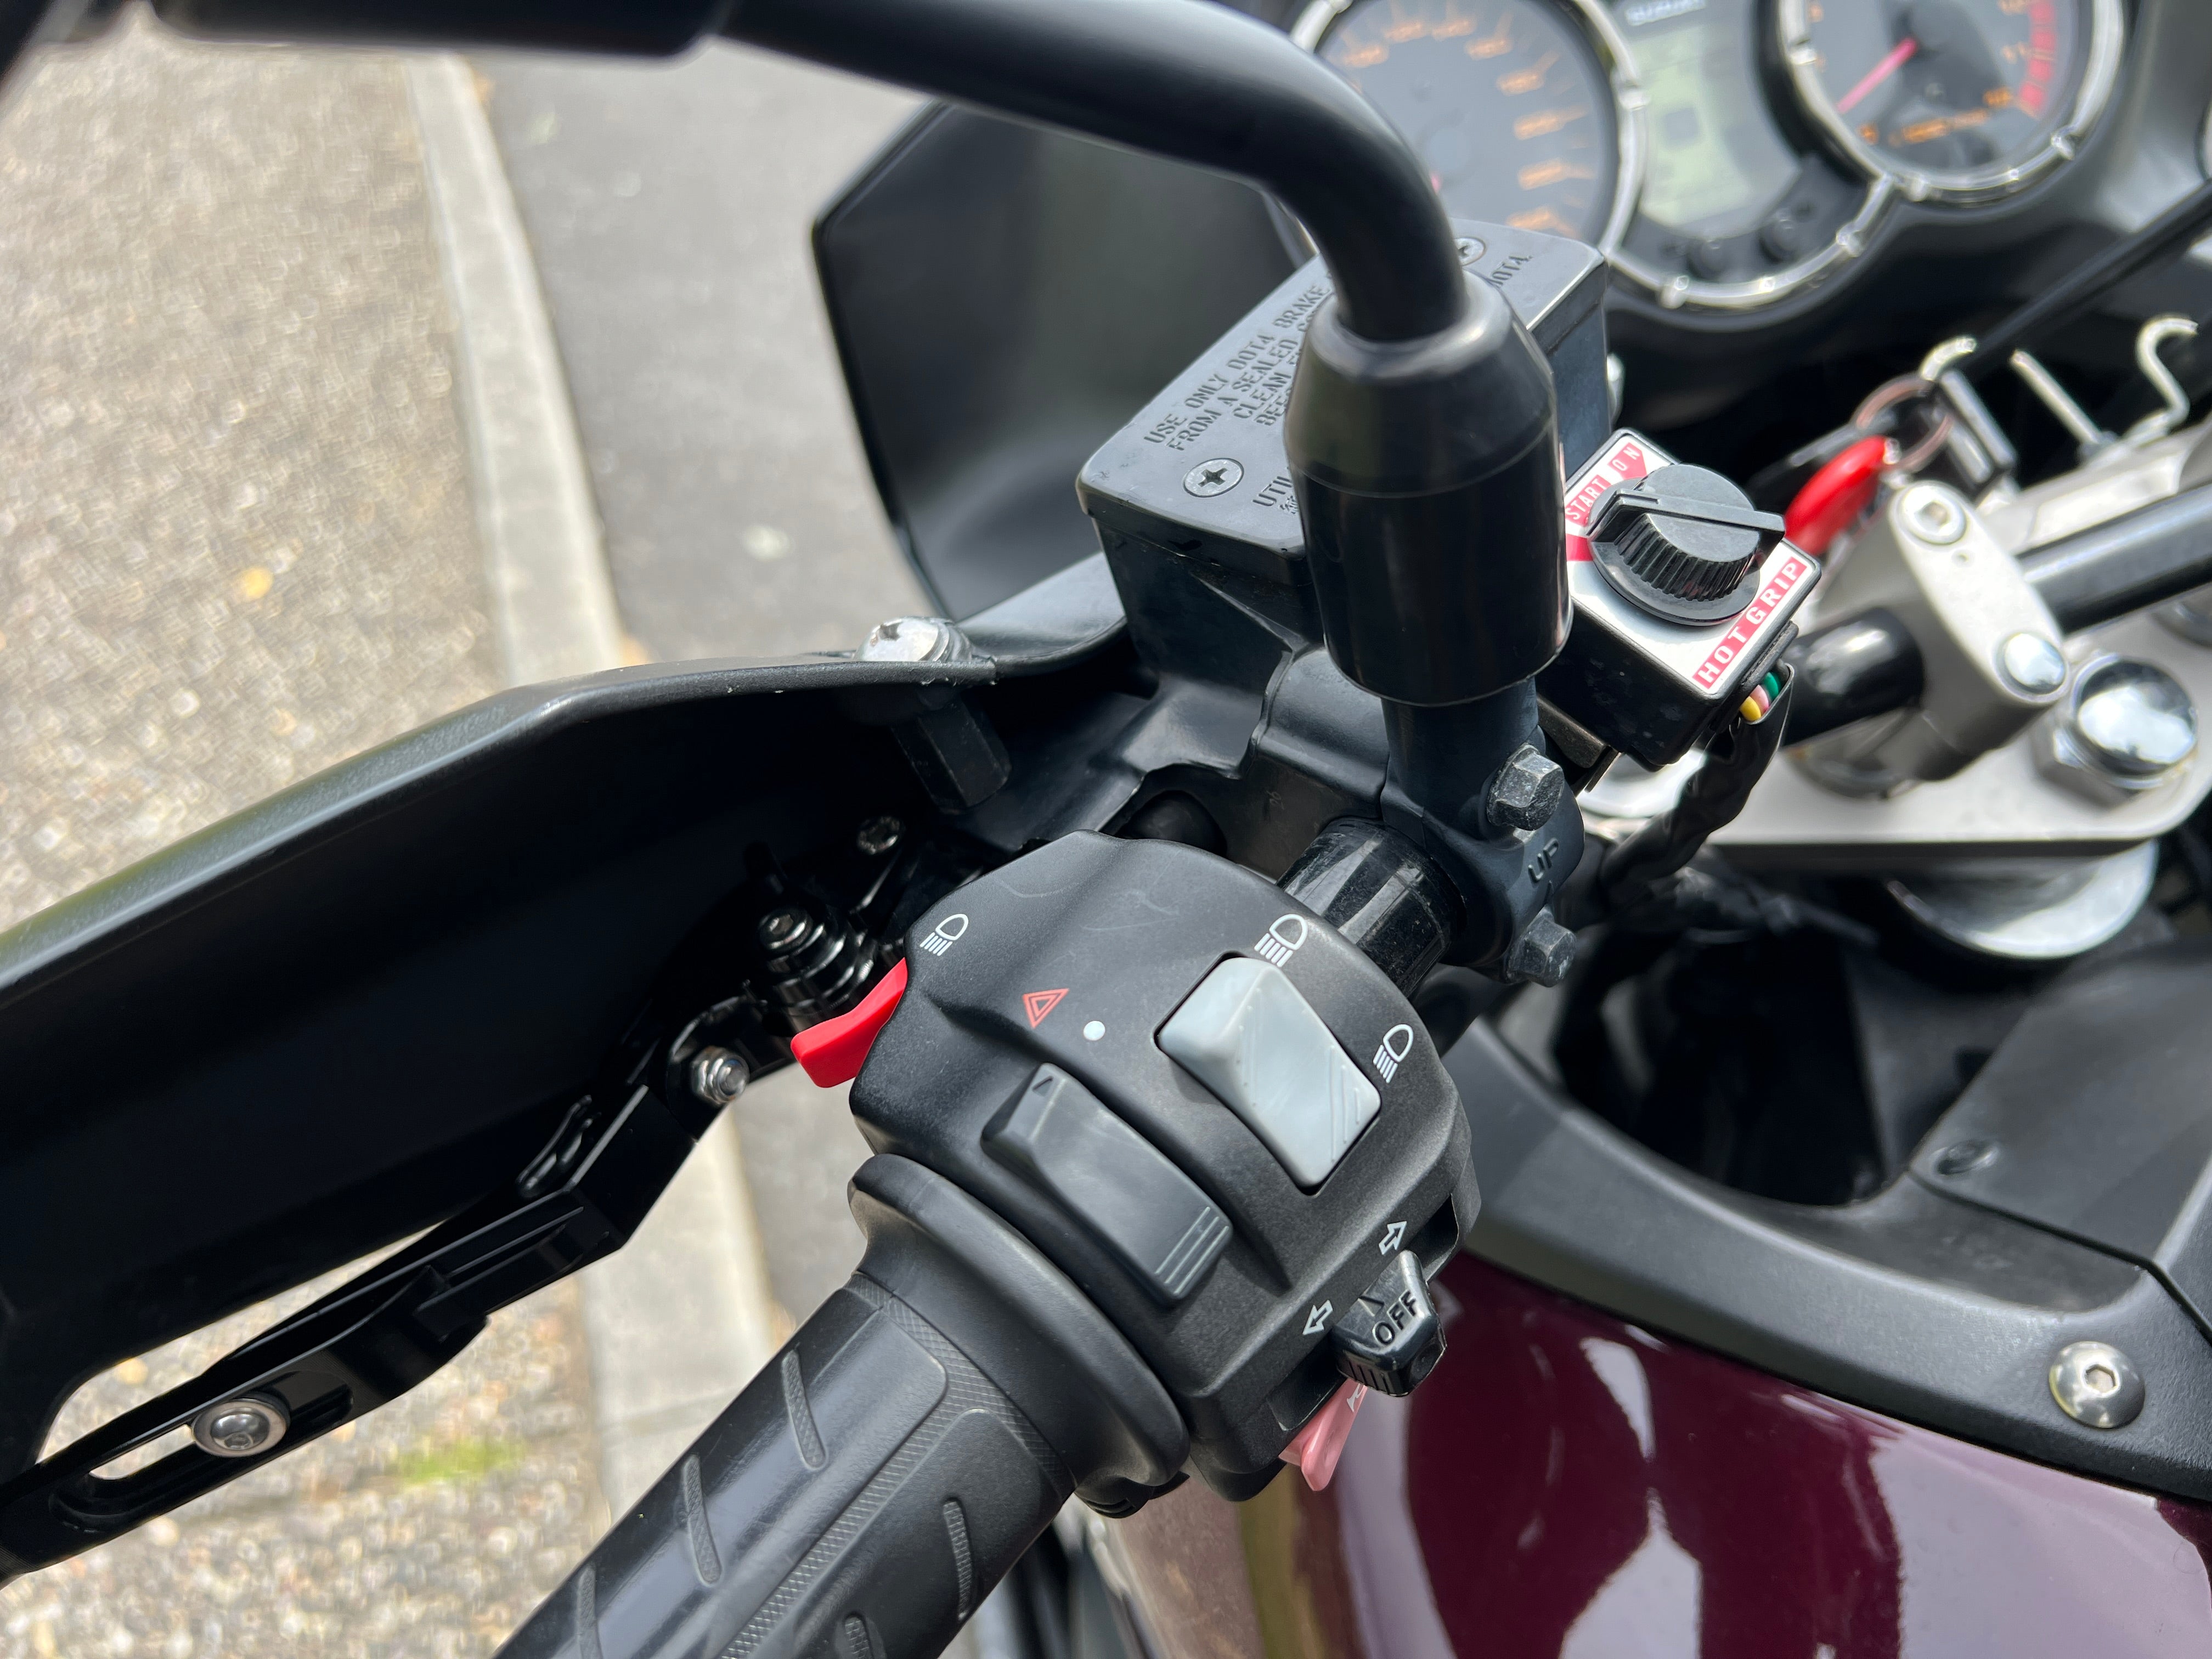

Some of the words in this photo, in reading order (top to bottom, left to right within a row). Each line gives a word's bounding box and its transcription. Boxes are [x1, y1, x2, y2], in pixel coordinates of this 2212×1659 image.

[1144, 414, 1187, 443] USE
[1185, 374, 1229, 408] ONLY
[1227, 334, 1275, 370] DOT4
[1272, 285, 1331, 329] BRAKE
[1165, 409, 1222, 451] FROM
[1217, 396, 1238, 407] A
[1232, 338, 1298, 392] SEALED
[1233, 372, 1291, 419] CLEAN
[1565, 478, 1607, 520] START
[1612, 446, 1640, 471] ON
[1697, 626, 1747, 683] HOT
[1746, 562, 1798, 625] GRIP
[1528, 837, 1559, 884] UP
[1372, 1290, 1420, 1346] OFF
